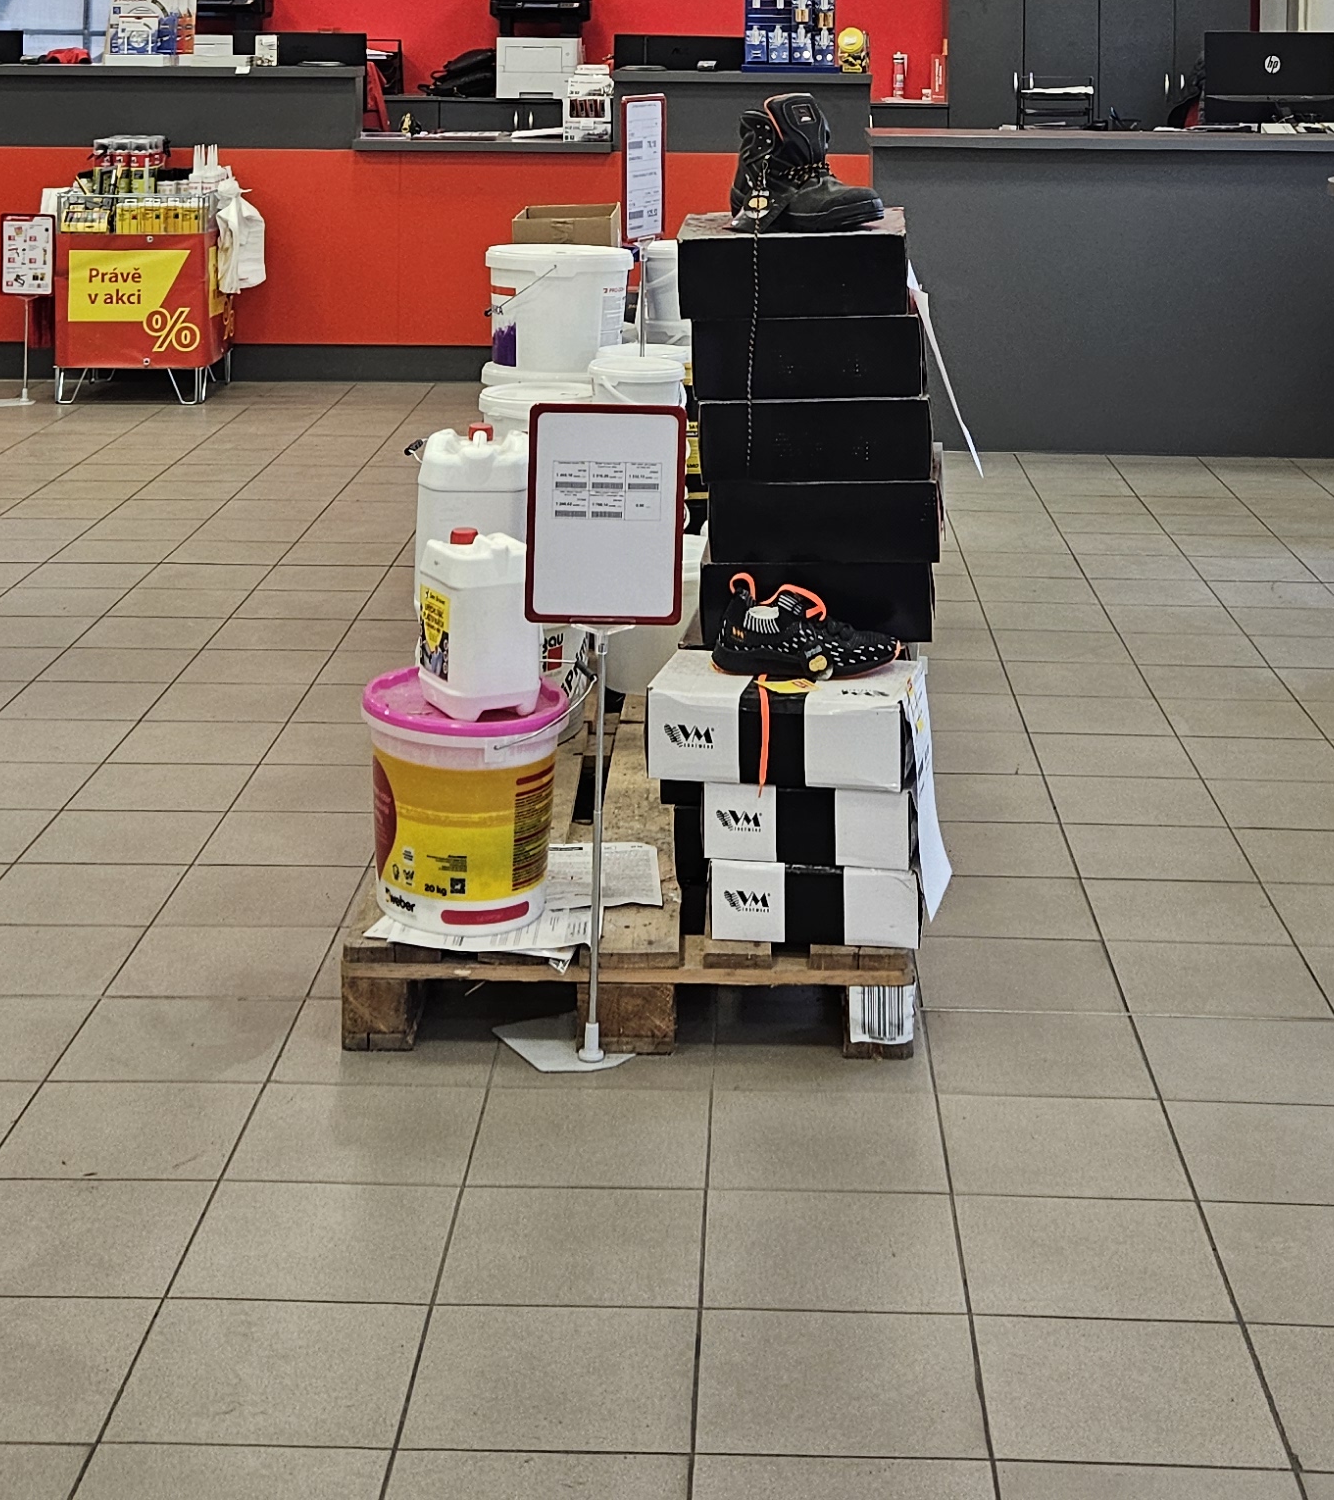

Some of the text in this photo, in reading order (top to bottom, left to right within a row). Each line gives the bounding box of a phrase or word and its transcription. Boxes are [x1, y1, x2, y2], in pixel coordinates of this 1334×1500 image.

[1267, 55, 1280, 73] hp
[88, 266, 142, 284] Právě
[88, 289, 142, 305] v akci
[143, 307, 201, 352] %
[677, 724, 714, 744] VM
[728, 809, 762, 828] VM
[424, 883, 448, 897] 20 kg
[736, 889, 770, 909] VM
[390, 895, 416, 913] weber
